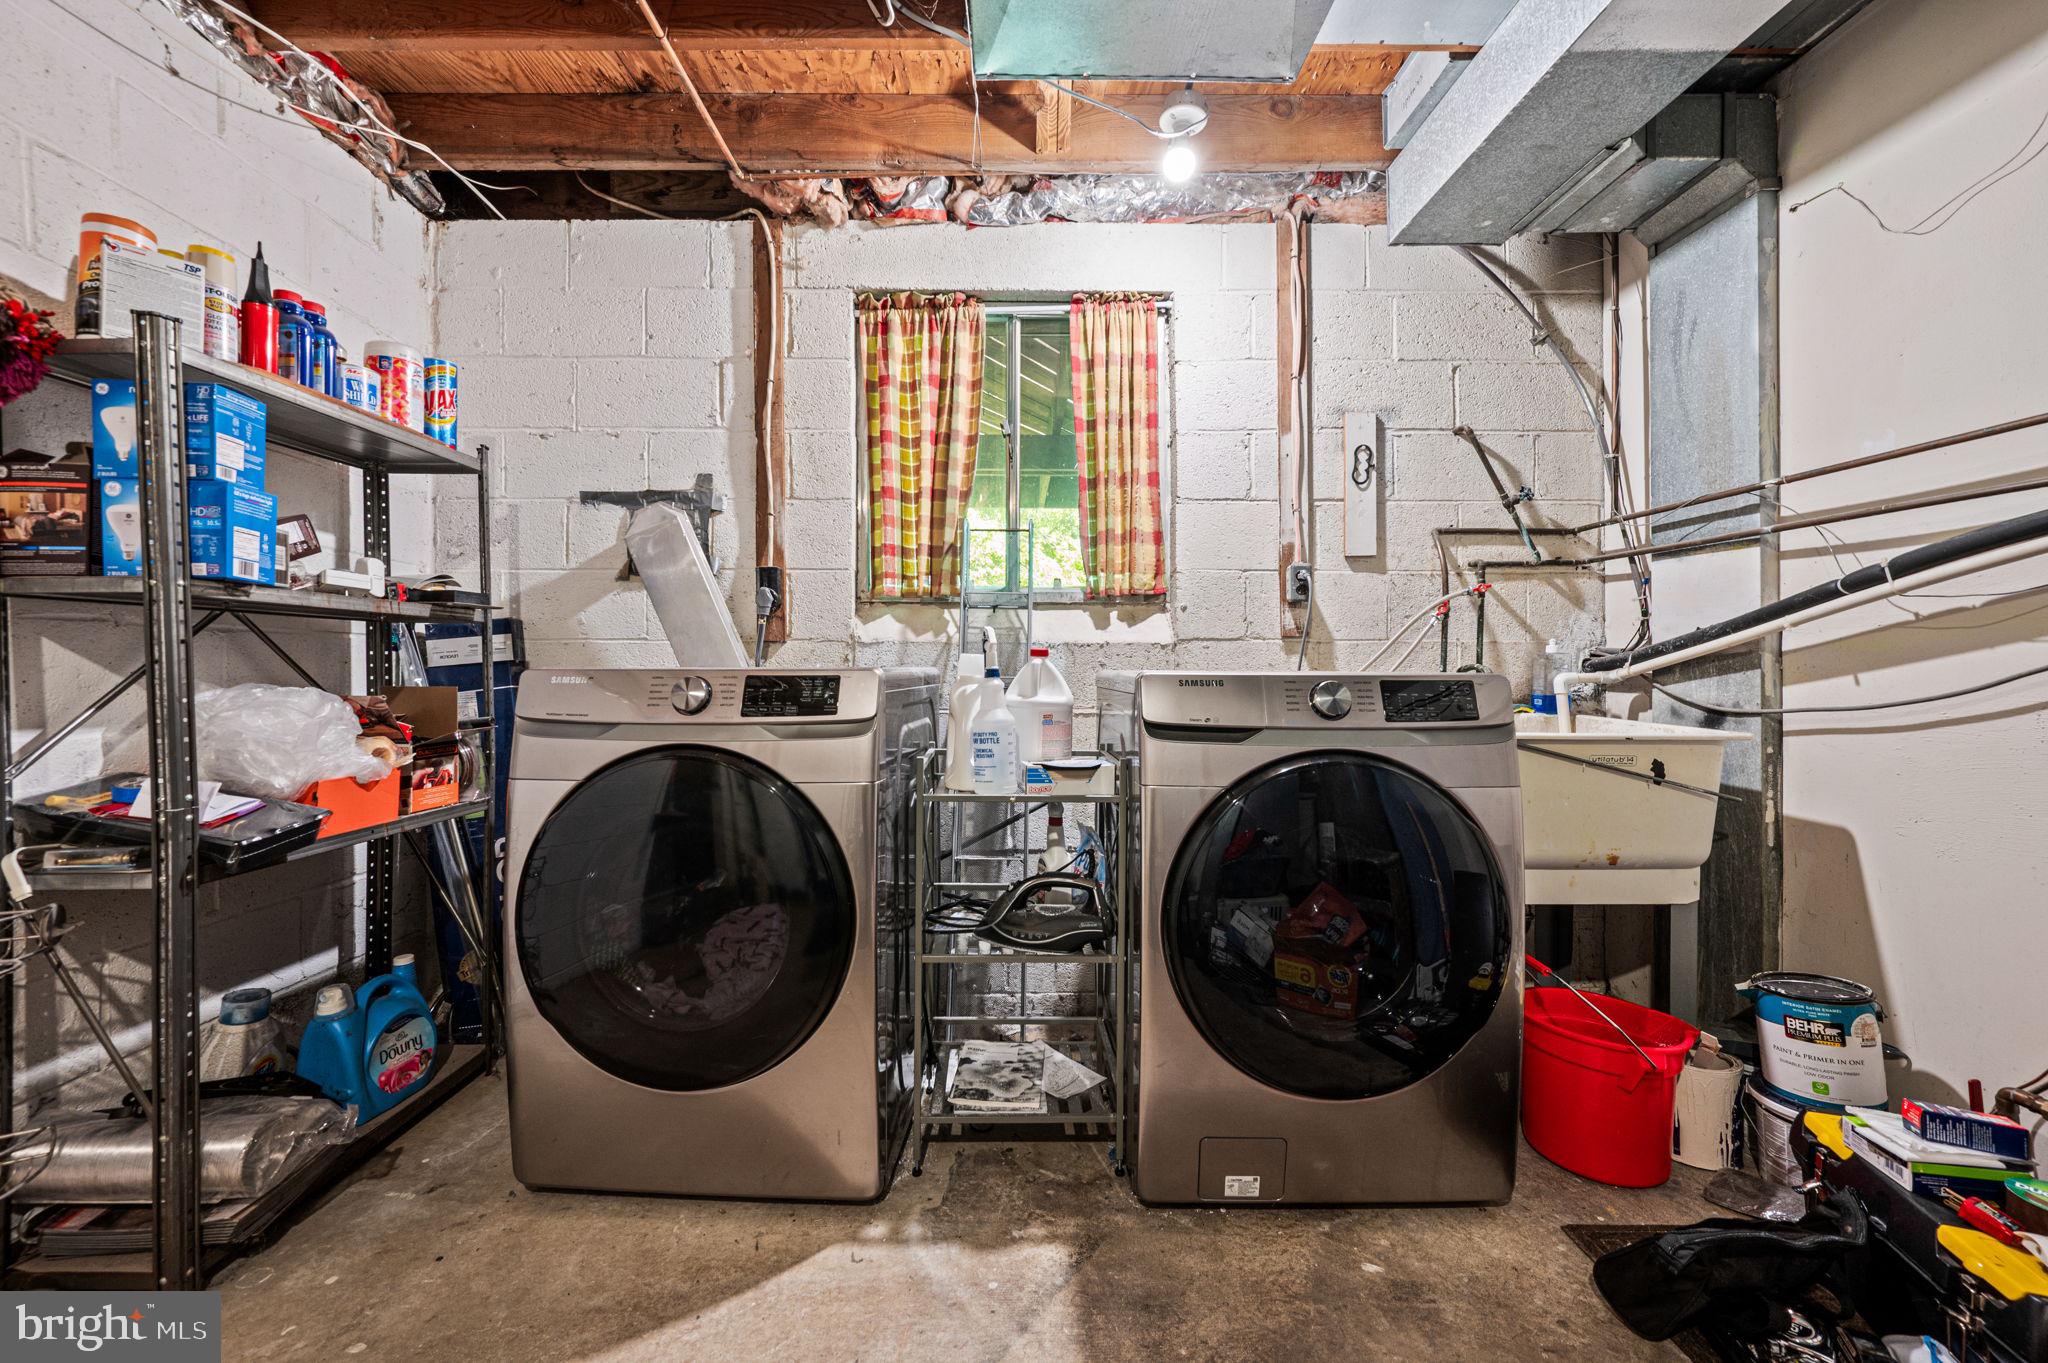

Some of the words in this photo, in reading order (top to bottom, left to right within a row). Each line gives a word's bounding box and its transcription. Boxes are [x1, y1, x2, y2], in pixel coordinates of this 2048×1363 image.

[184, 263, 202, 274] TSP
[193, 414, 209, 422] LIFE
[1178, 679, 1225, 687] SAMSUNG
[979, 737, 1001, 745] BOTTLE
[1786, 1017, 1825, 1035] BEHR
[1787, 1028, 1822, 1041] PREMIUM
[1823, 1034, 1842, 1042] PLUS
[379, 1034, 424, 1065] Downy
[1772, 1044, 1792, 1055] PAINT
[1803, 1053, 1836, 1064] PRIMER
